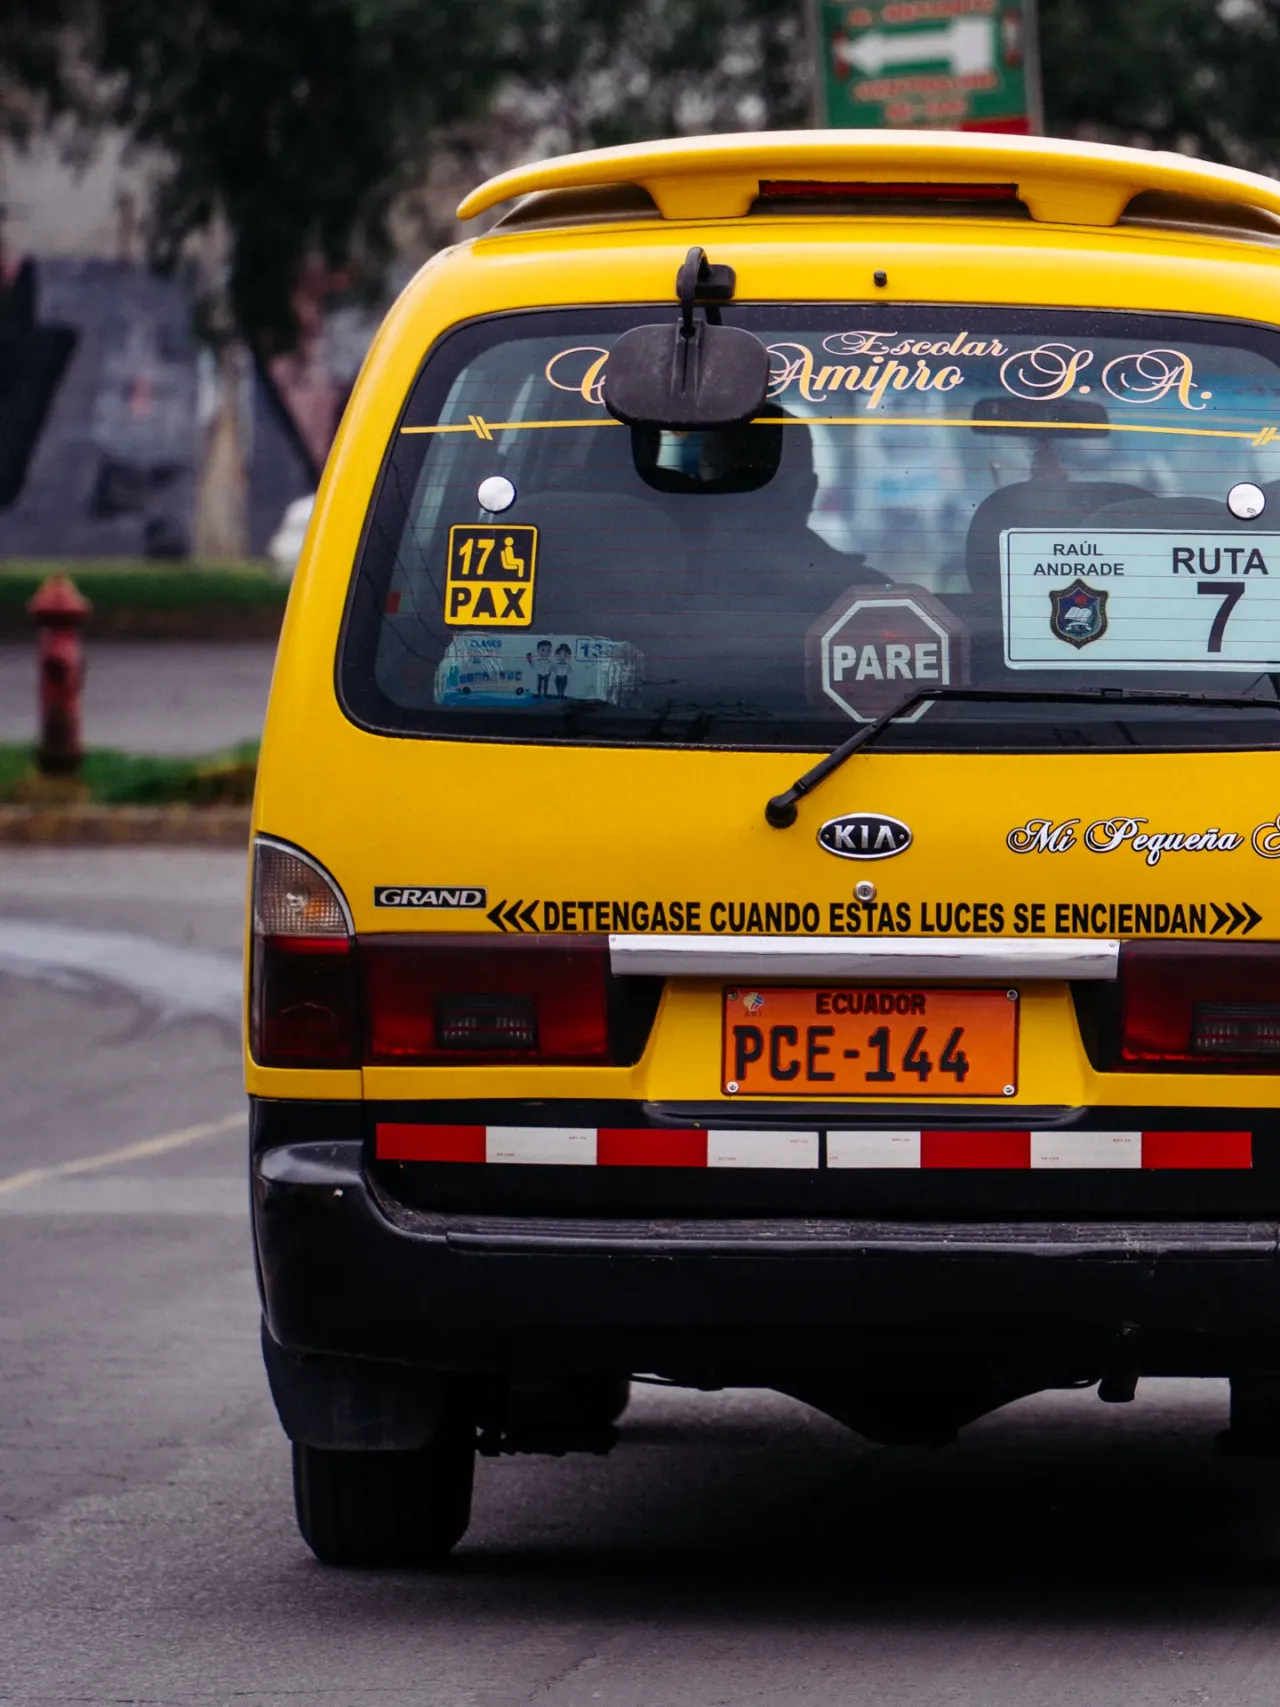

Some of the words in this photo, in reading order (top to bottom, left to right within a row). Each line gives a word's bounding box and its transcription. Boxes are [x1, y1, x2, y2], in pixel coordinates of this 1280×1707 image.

[822, 330, 1008, 357] Escolar
[767, 342, 965, 410] Amipro
[1000, 343, 1094, 401] S.
[1102, 349, 1213, 411] A.
[458, 538, 496, 575] 17
[1053, 541, 1104, 556] RAÚL
[1172, 547, 1269, 575] RUTA
[1033, 563, 1125, 576] ANDRADE
[450, 587, 527, 619] PAX
[1197, 582, 1246, 653] 7
[832, 643, 939, 681] PARE
[833, 824, 897, 850] KIA
[1006, 818, 1079, 854] Mi
[1085, 816, 1243, 866] Pequeña
[379, 889, 482, 906] GRAND
[543, 901, 701, 932] DETENGASE
[710, 902, 820, 933] CUANDO
[829, 902, 912, 933] ESTAS
[920, 903, 1005, 933] LUCES
[1013, 903, 1046, 933] SE
[1055, 903, 1207, 934] ENCIENDAN
[815, 993, 927, 1015] ECUADOR
[733, 1025, 969, 1082] PCE-144
